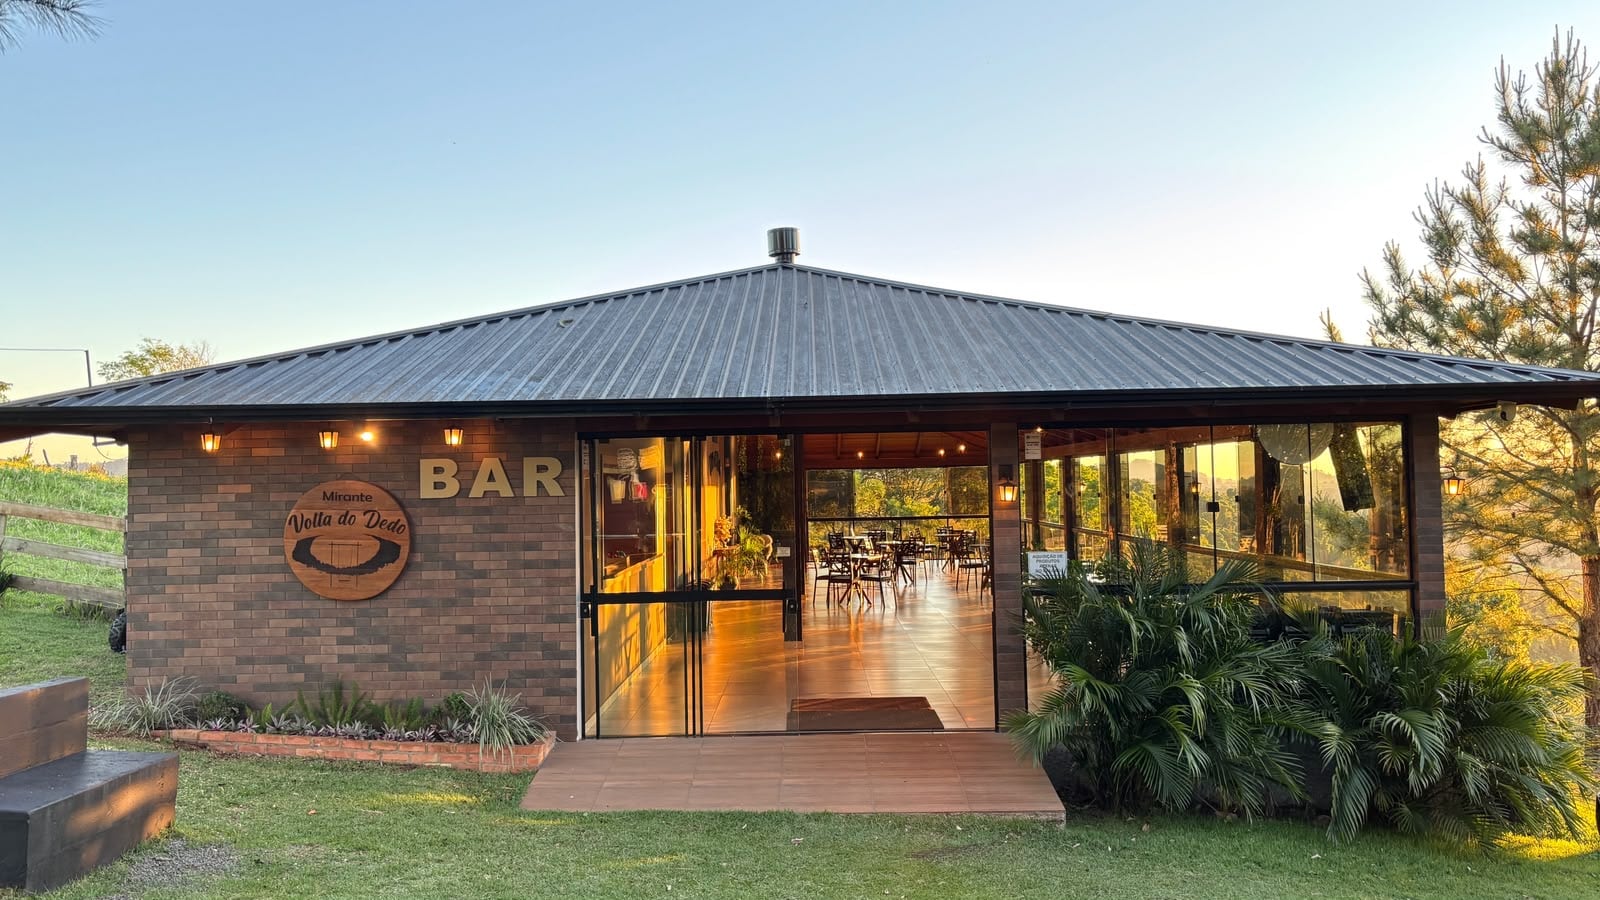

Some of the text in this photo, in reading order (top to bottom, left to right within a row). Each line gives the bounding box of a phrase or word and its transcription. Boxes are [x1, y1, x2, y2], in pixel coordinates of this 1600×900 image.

[420, 457, 565, 499] BAR
[322, 490, 373, 502] Mirante
[288, 509, 406, 535] Volta do Dedo
